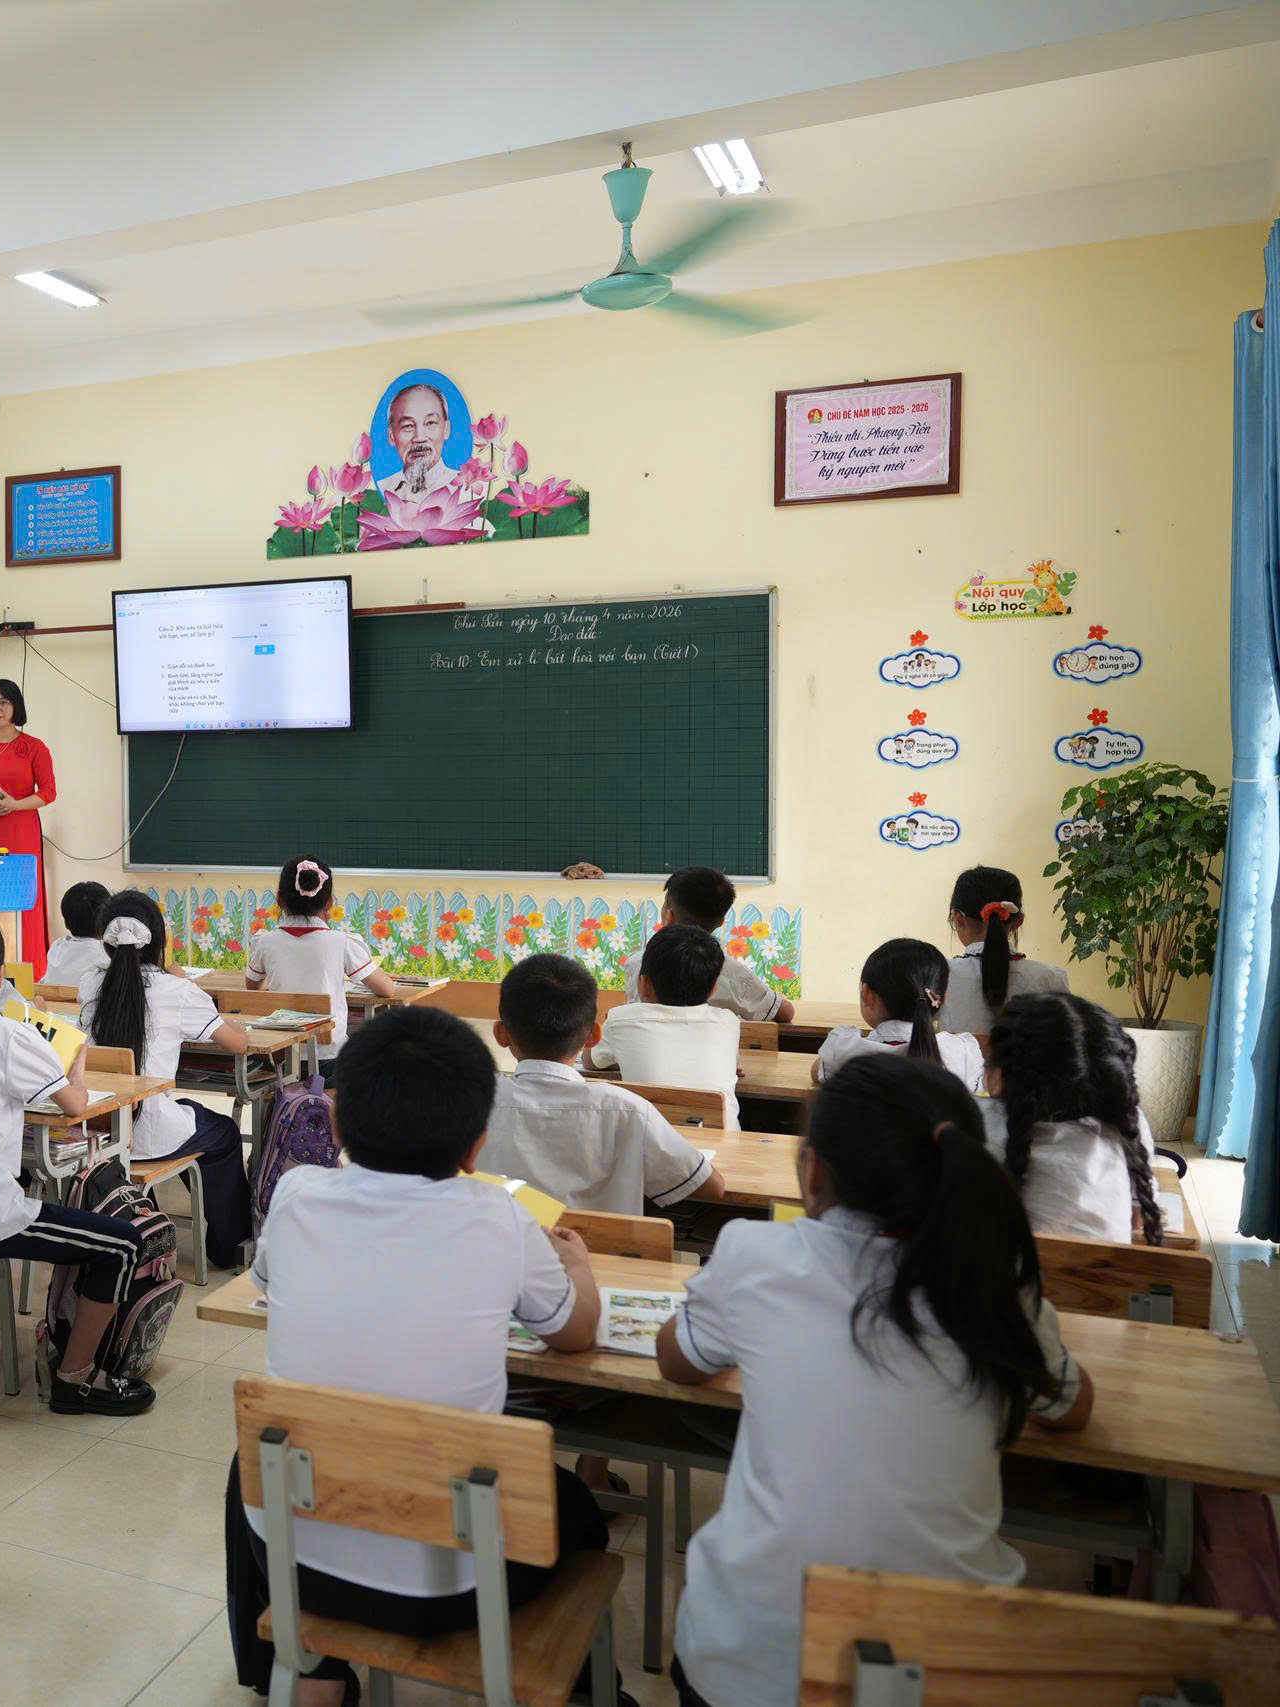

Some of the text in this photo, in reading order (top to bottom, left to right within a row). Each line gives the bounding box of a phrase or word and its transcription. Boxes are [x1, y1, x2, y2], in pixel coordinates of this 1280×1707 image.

[827, 408, 841, 421] CHỦ
[871, 406, 886, 419] HỌC
[888, 405, 905, 416] 2025
[911, 402, 929, 413] 2026
[845, 429, 863, 441] nhi
[861, 426, 905, 441] Phượng
[905, 421, 931, 437] Tiến
[848, 446, 877, 459] bước
[878, 442, 901, 456] tiến
[903, 443, 925, 454] vào
[837, 463, 880, 479] nguyên
[972, 587, 1025, 600] Nội quy
[972, 601, 1028, 614] Lớp học
[454, 612, 477, 630] Thứ
[510, 614, 540, 633] ngày
[543, 611, 556, 625] 10
[561, 606, 599, 632] tháng
[602, 607, 611, 620] 4
[617, 609, 646, 621] năm
[647, 604, 683, 619] 2026
[430, 653, 456, 670] Bài
[477, 649, 500, 667] Em
[545, 648, 566, 665] bất
[621, 644, 647, 664] bạn
[1098, 662, 1120, 670] đúng
